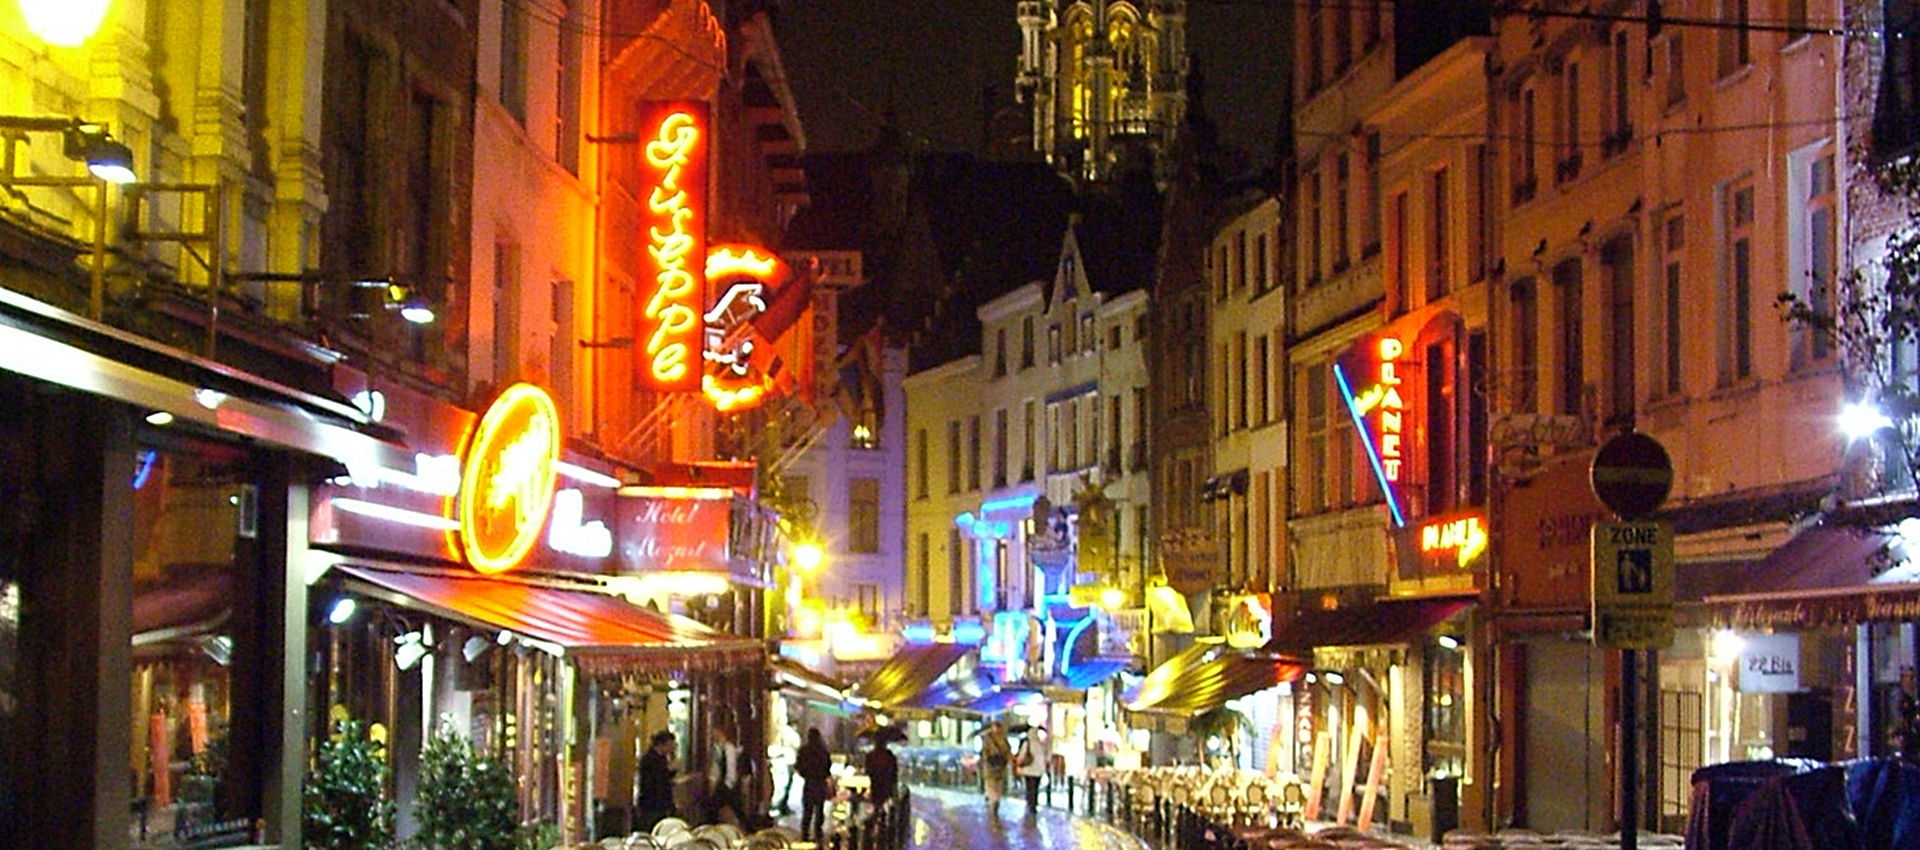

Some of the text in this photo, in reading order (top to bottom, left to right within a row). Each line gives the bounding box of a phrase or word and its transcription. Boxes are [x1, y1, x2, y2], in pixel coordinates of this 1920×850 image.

[645, 112, 698, 381] Giuseppe
[1379, 338, 1403, 482] PLANET
[635, 501, 699, 523] Hotel
[625, 535, 707, 566] Mozart
[1611, 526, 1659, 545] ZONE
